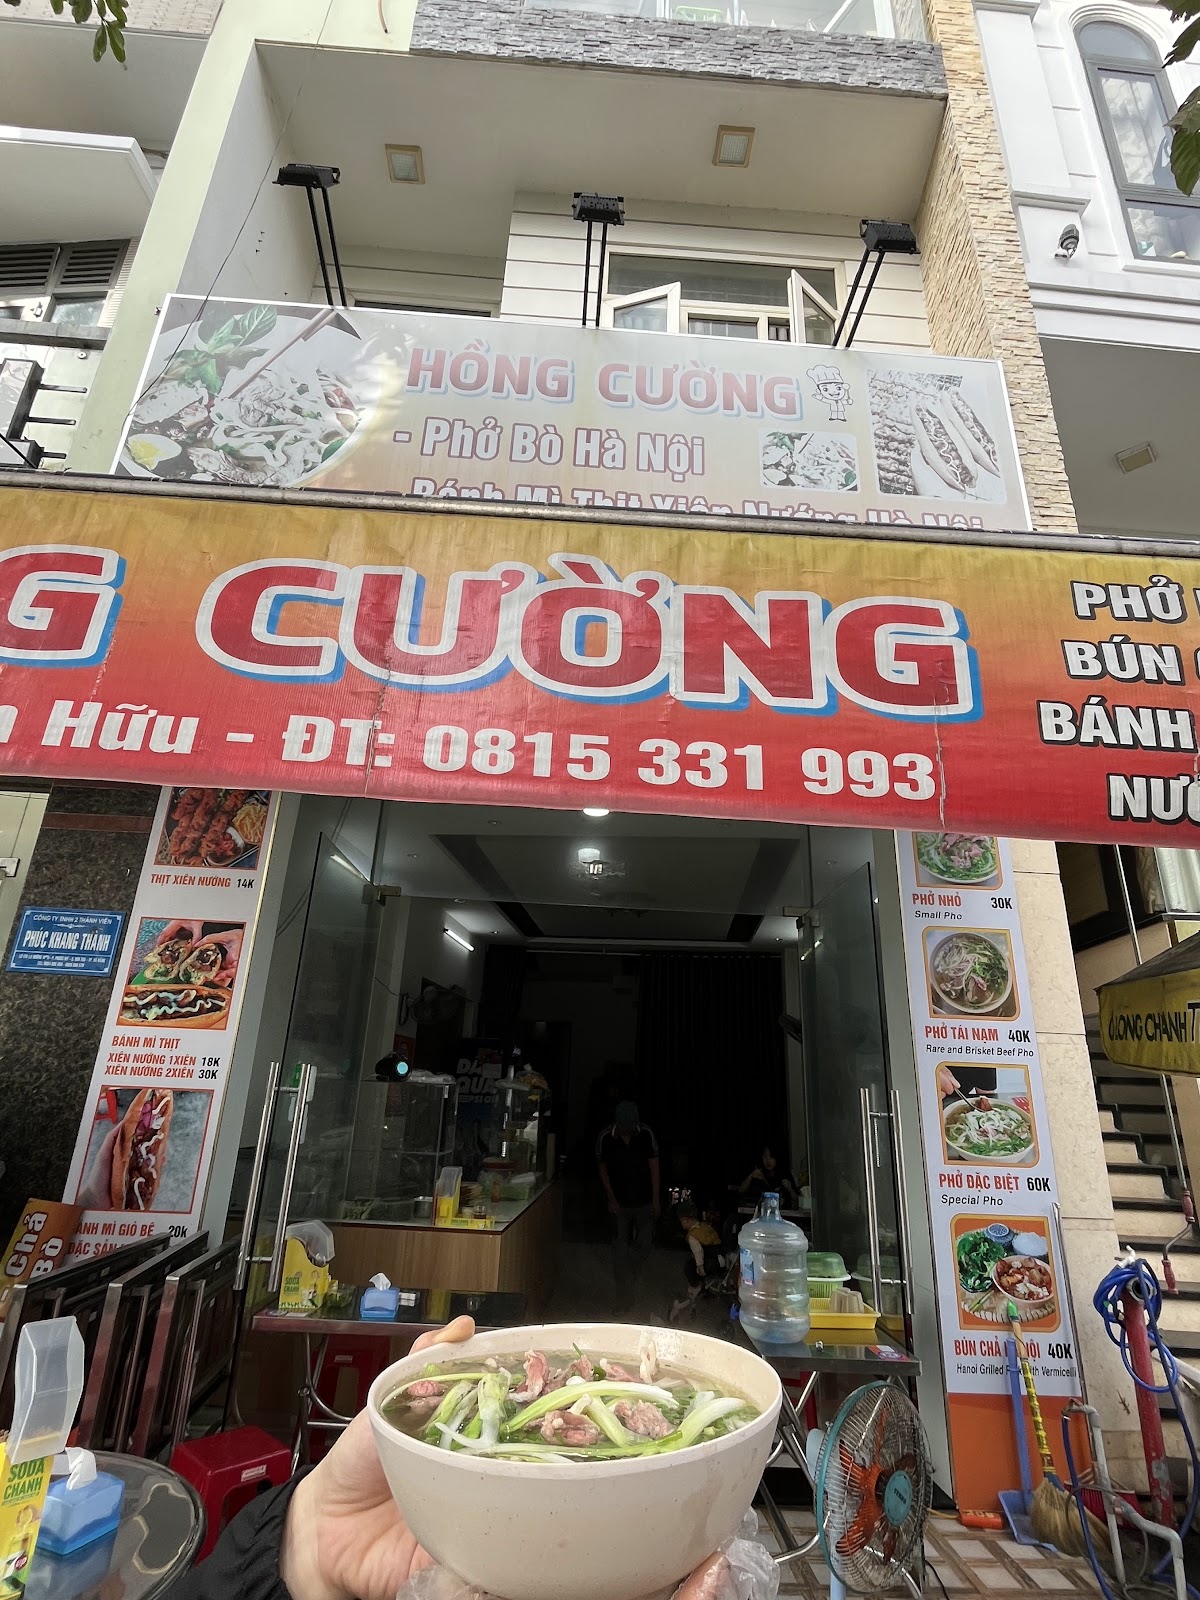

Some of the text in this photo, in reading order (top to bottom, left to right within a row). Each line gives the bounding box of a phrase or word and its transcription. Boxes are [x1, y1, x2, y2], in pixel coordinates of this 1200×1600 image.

[405, 338, 802, 420] HỒNG CƯỜNG
[420, 416, 502, 461] Phở
[510, 422, 564, 465] Bò
[573, 427, 627, 470] Hà
[637, 432, 705, 482] Nội
[1070, 575, 1187, 624] PHỞ
[195, 552, 981, 721] CƯỜNG
[1061, 634, 1186, 686] BÚN
[1037, 694, 1199, 754] BÁNH
[41, 700, 200, 754] Hữu
[281, 714, 395, 768] ĐT:
[423, 725, 611, 781] 0815
[638, 738, 763, 791] 331
[801, 747, 936, 800] 993
[150, 873, 255, 889] THỊT XIÊN NƯỚNG 14K
[912, 890, 1013, 910] PHỞ NHỎ 30K
[914, 910, 963, 920] Small Pho
[22, 927, 49, 948] PHÚC
[48, 931, 80, 950] KHANG
[112, 1034, 181, 1051] BÁNH MÌ THỊT
[924, 1021, 1031, 1044] PHỞ TÁI NẠM 40K
[107, 1051, 221, 1067] XIÊN NƯỚNG 1XIÊN 18K
[926, 1044, 1034, 1057] Rare and Brisket Beef Pho
[104, 1064, 218, 1080] XIÊN NƯỚNG 2XIÊN 30K
[938, 1169, 1051, 1194] PHỞ ĐẶC BIỆT 60K
[941, 1194, 1004, 1206] Special Pho
[75, 1220, 100, 1235] ÁNH
[101, 1220, 117, 1236] MÌ
[5, 1211, 48, 1277] Chả
[954, 1336, 977, 1356] BÚN
[979, 1335, 1002, 1357] CHẢ
[1047, 1343, 1073, 1360] 40K
[956, 1363, 978, 1374] Hanoi
[980, 1363, 1004, 1375] Grilled
[8, 1457, 45, 1483] SODA
[4, 1475, 44, 1500] CHANH
